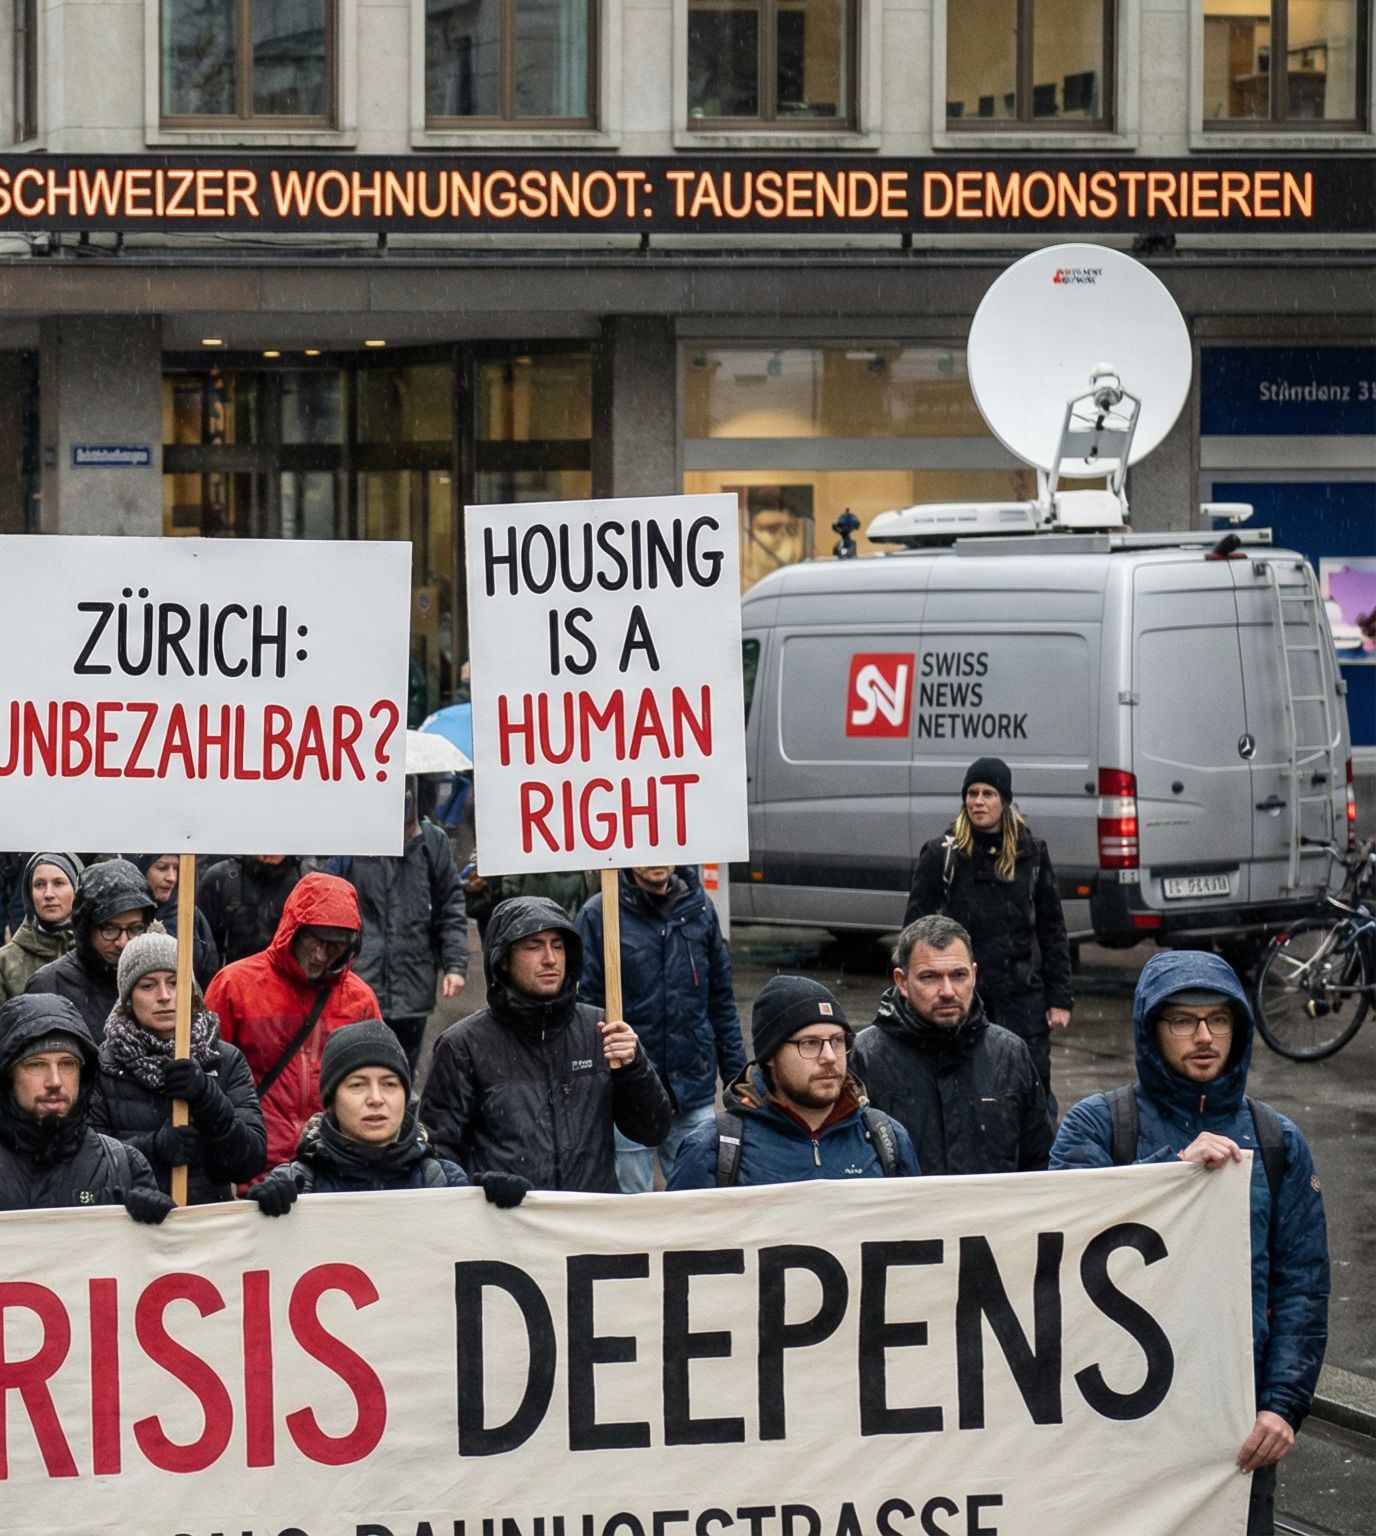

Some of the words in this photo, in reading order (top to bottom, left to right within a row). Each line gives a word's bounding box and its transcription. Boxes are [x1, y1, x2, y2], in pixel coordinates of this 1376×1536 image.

[270, 168, 654, 219] WOHNUNGSNOT:
[666, 169, 910, 219] TAUSENDE
[923, 169, 1314, 219] DEMONSTRIEREN
[483, 514, 724, 597] HOUSING
[73, 587, 308, 679] ZÜRICH:
[548, 607, 597, 676] IS
[618, 604, 660, 673] A
[921, 652, 989, 677] SWISS
[497, 684, 713, 767] HUMAN
[917, 713, 1028, 740] NETWORK
[919, 682, 983, 708] NEWS
[520, 773, 700, 854] RIGHT
[454, 1222, 1176, 1458] DEEPENS
